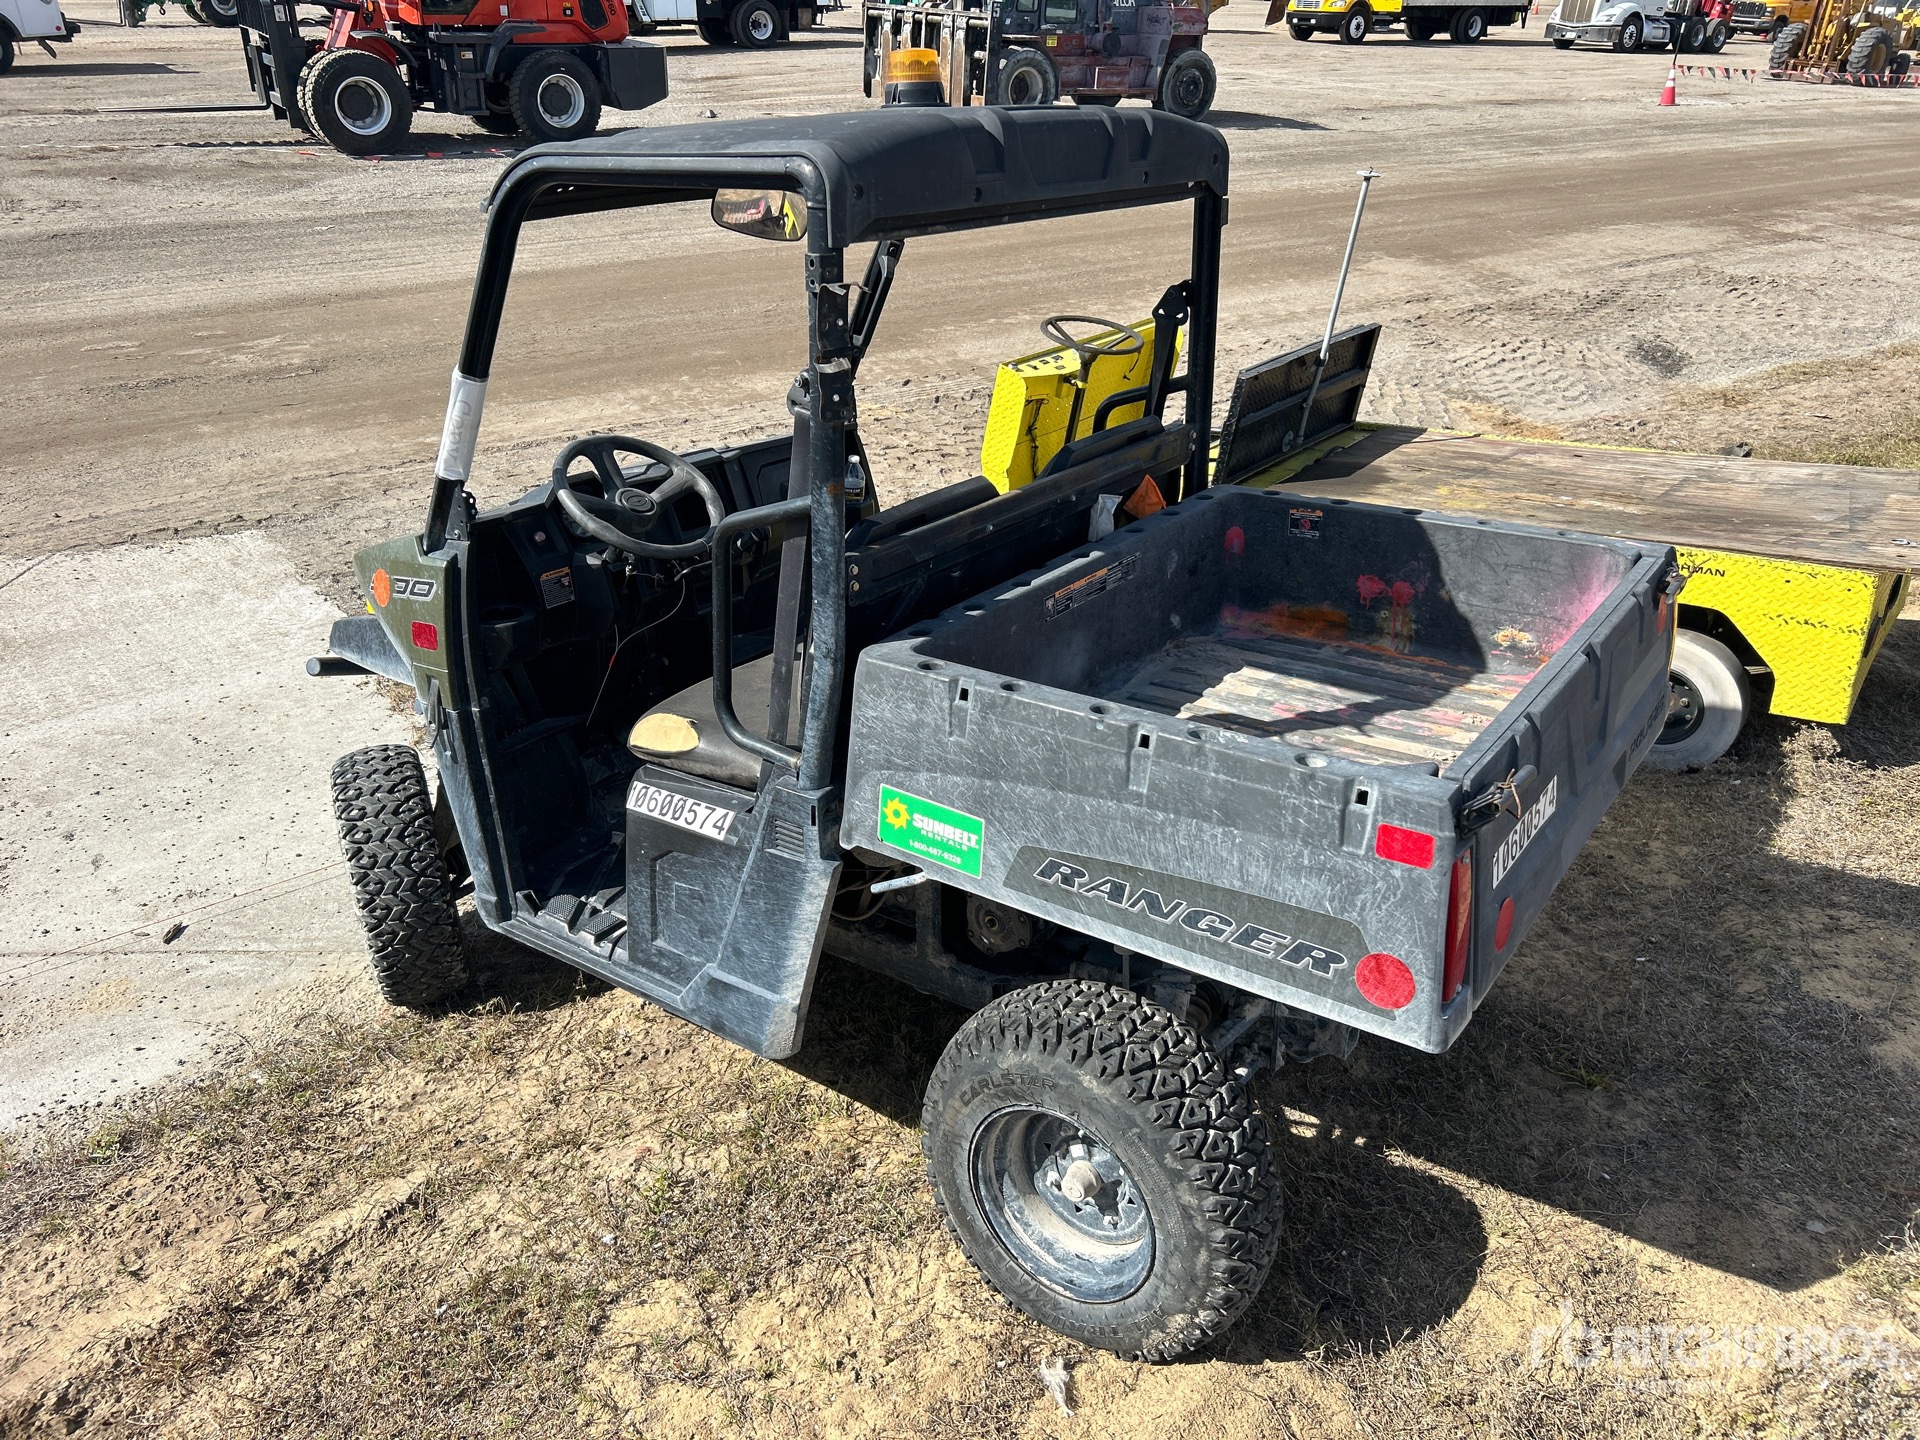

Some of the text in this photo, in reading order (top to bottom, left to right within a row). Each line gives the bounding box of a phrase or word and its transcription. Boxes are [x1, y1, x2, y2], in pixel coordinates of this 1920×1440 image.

[628, 782, 730, 836] 10600574
[912, 812, 979, 849] SUNBELT
[1493, 778, 1556, 882] 10600574
[920, 829, 968, 852] RENTALS
[1033, 857, 1349, 979] RANGER
